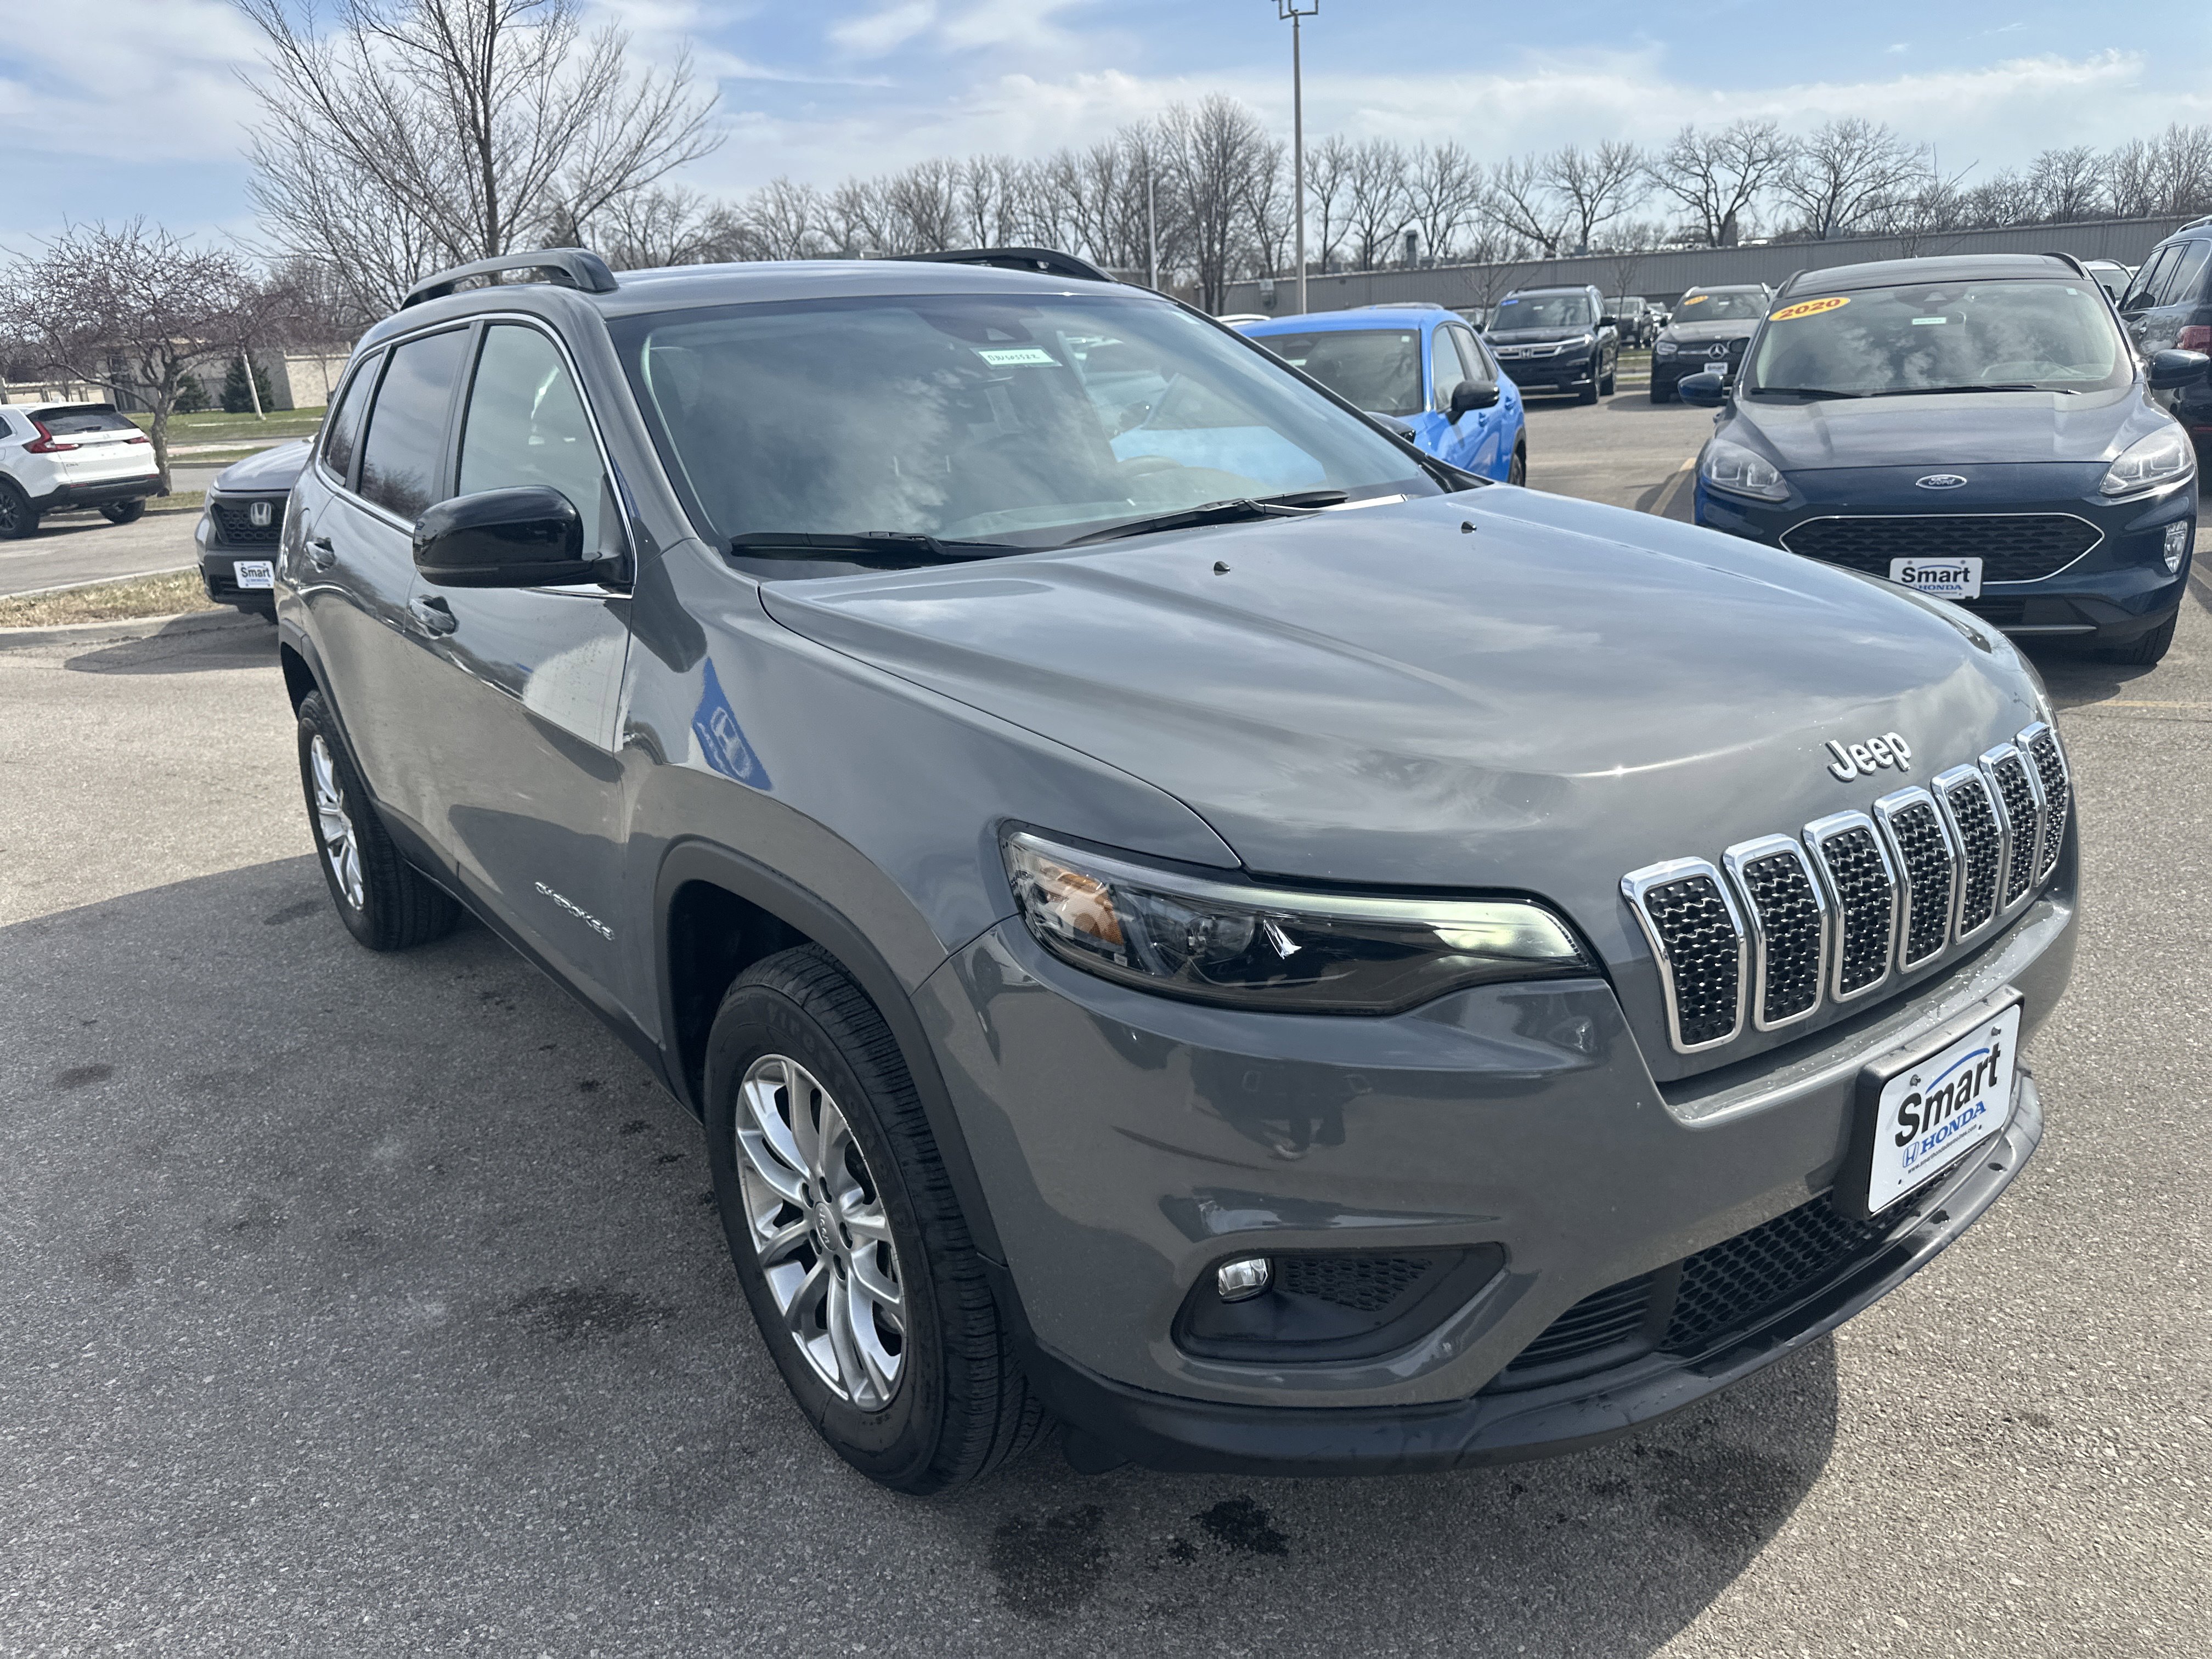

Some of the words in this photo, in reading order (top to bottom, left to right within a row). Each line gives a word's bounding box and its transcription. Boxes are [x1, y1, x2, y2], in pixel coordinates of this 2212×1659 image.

[1779, 299, 1841, 319] 2020
[1928, 477, 1955, 486] Ford
[241, 567, 271, 578] Smart
[1901, 567, 1970, 583] Smart
[1825, 732, 1911, 782] Jeep
[1895, 1042, 2001, 1147] Smart
[1920, 1101, 1986, 1155] HONDA
